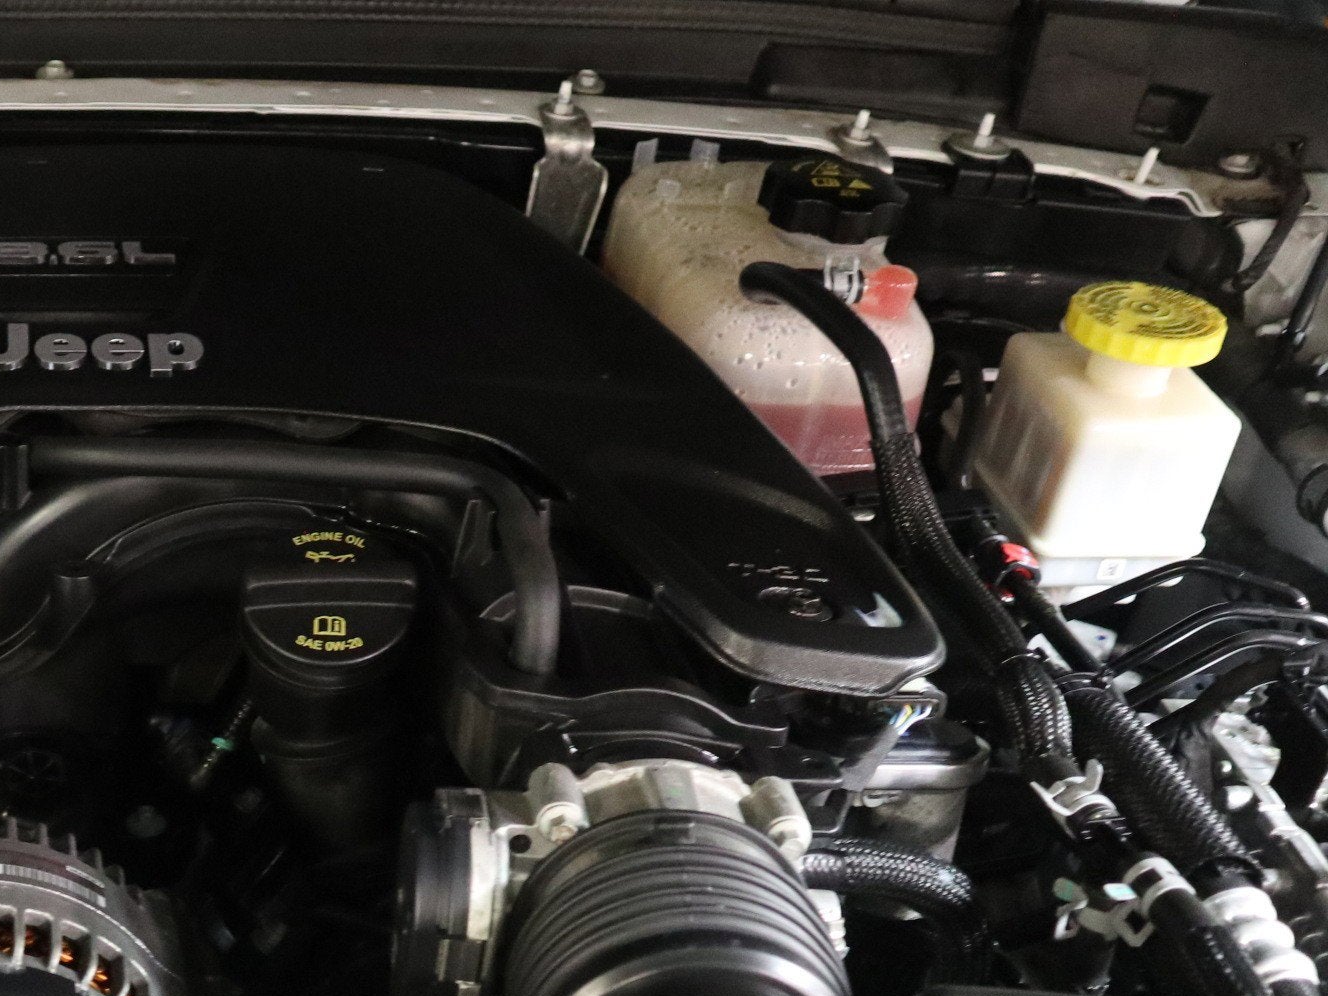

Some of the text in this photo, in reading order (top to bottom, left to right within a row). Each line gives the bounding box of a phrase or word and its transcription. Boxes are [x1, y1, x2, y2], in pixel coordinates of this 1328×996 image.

[292, 531, 366, 548] ENGINE OIL
[295, 635, 323, 651] SAE
